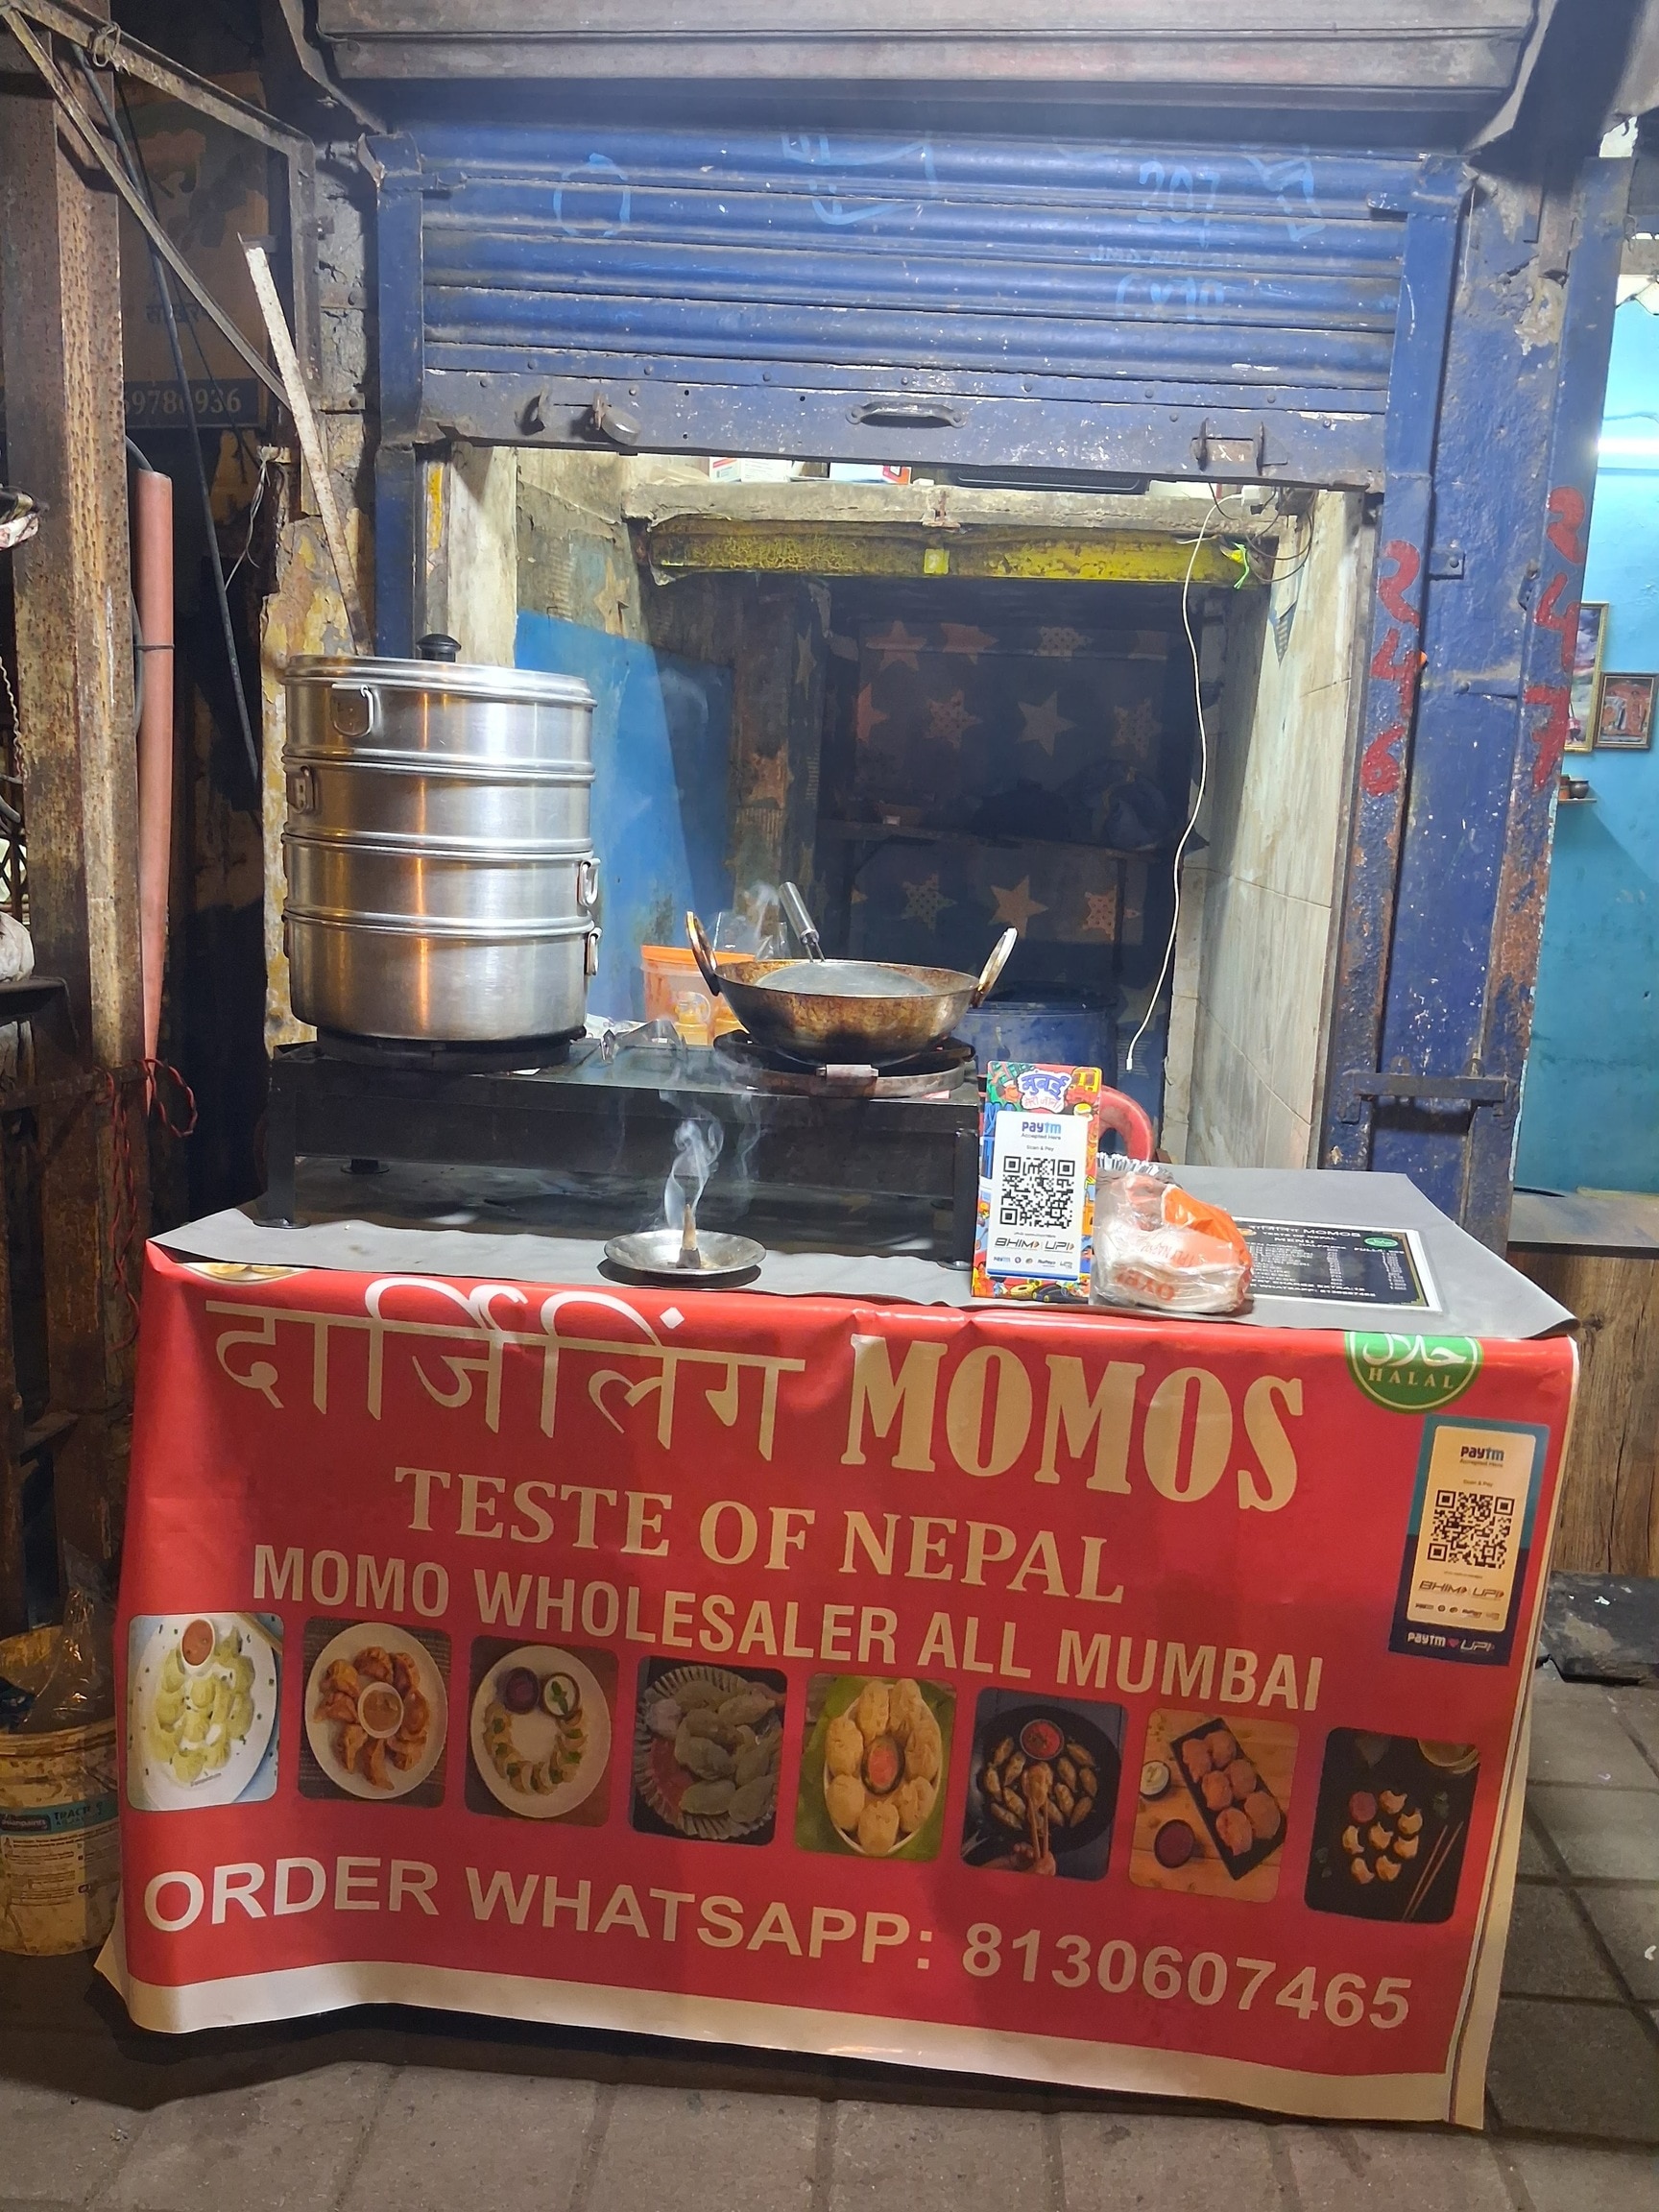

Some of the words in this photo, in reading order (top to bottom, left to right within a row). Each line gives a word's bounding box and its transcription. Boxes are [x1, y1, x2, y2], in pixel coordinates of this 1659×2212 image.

[995, 1238, 1034, 1248] BHIM
[1046, 1241, 1070, 1251] UPI
[1368, 1366, 1454, 1389] HALAL
[841, 1334, 1303, 1512] MOMOS
[395, 1467, 672, 1557] TESTE
[698, 1501, 815, 1570] OF
[838, 1510, 1124, 1603] NEPAL
[253, 1545, 450, 1619] MOMO
[473, 1568, 899, 1664] WHOLESALER
[917, 1611, 1032, 1678] ALL
[1056, 1629, 1324, 1711] MUMBAI
[1419, 1580, 1464, 1595] BHIM
[1473, 1587, 1500, 1599] UPI
[1460, 1640, 1493, 1652] UPI
[144, 1856, 440, 1933] ORDER
[469, 1870, 933, 1970] WHATSAPP:
[961, 1923, 1412, 2030] 8130607465
